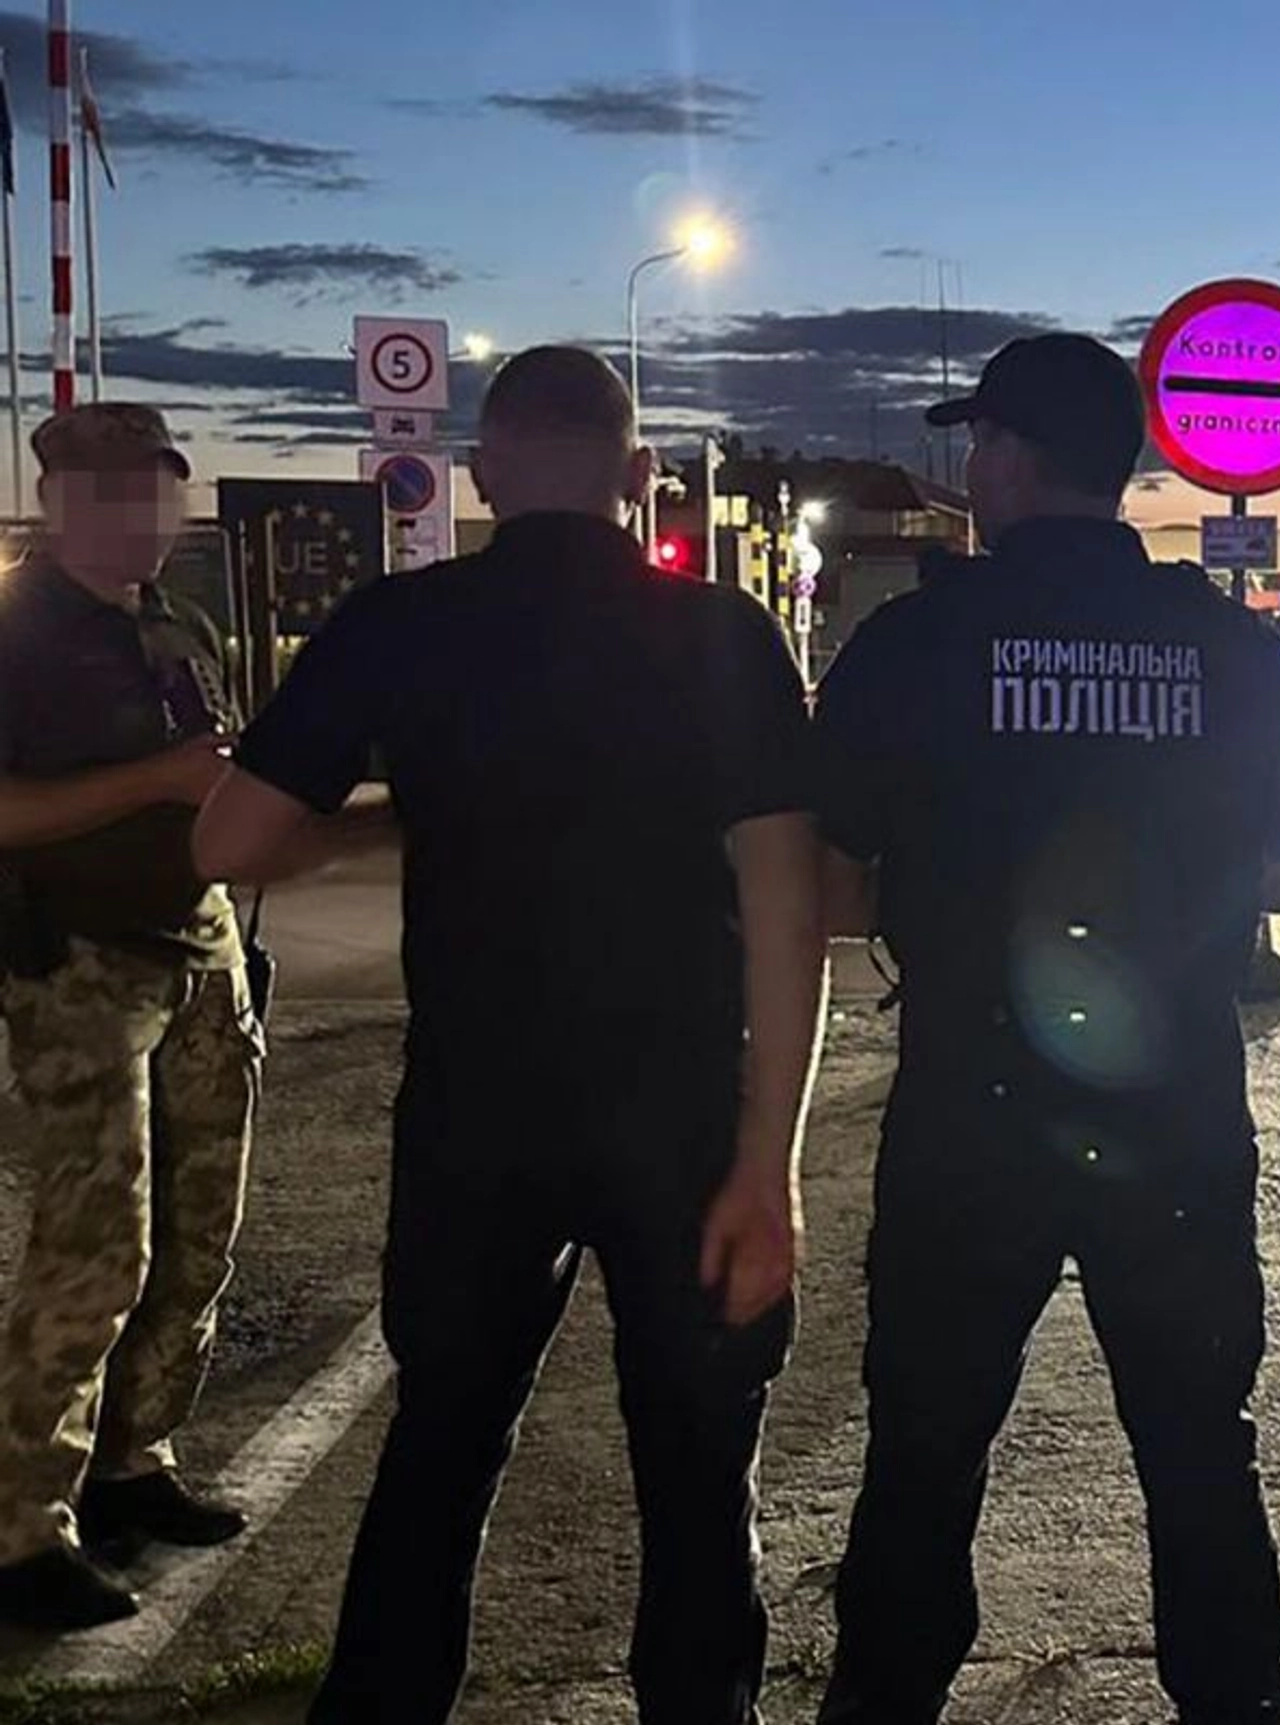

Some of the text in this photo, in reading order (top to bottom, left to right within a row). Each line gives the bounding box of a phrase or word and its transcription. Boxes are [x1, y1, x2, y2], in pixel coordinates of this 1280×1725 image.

[392, 349, 411, 379] 5
[275, 540, 328, 574] UE
[992, 638, 1203, 680] КРИМІНАЛЬНА
[992, 677, 1202, 742] ПОЛІЦІЯ
